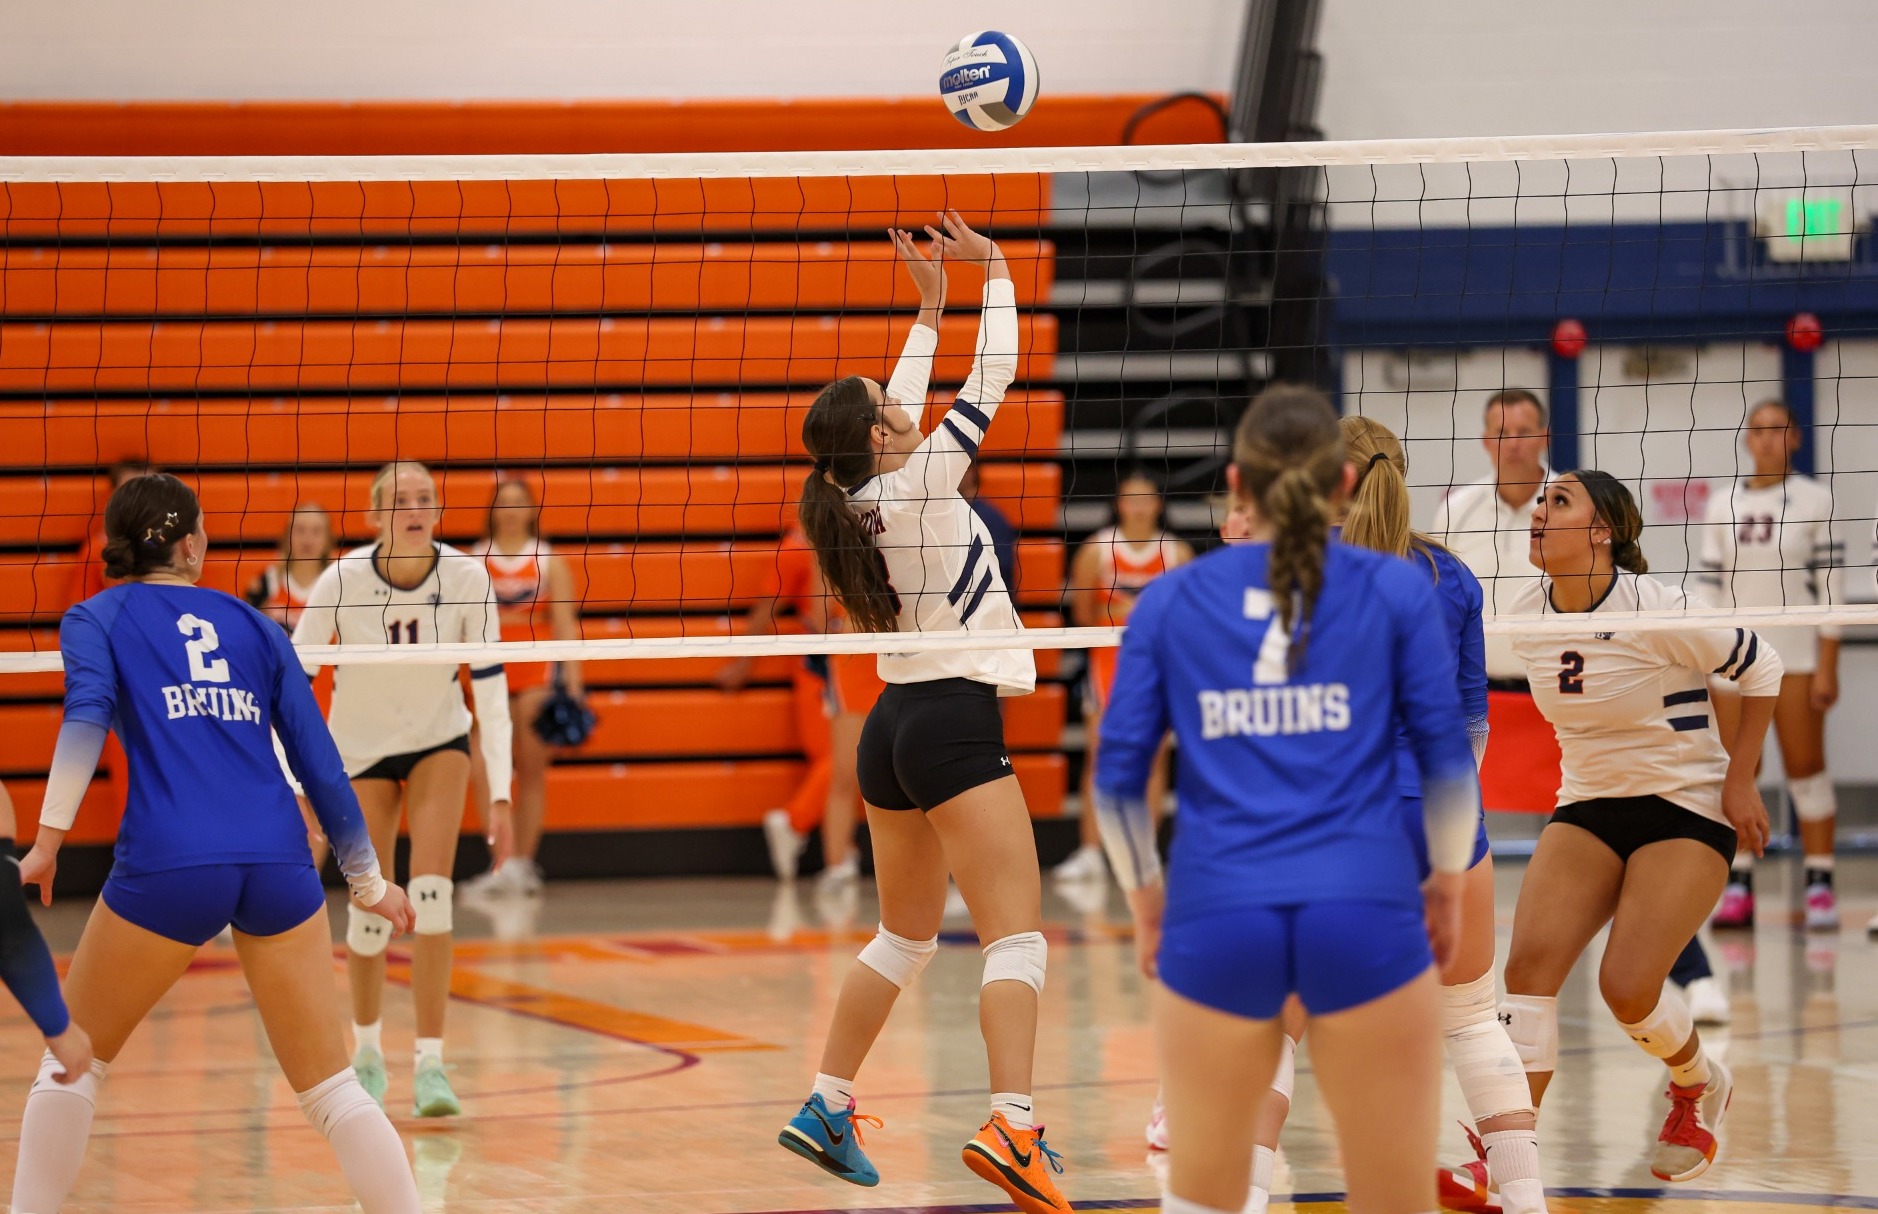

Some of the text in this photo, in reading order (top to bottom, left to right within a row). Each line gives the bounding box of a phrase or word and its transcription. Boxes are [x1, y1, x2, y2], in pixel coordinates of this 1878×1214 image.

[943, 65, 990, 89] molten
[176, 613, 231, 682] 2
[388, 618, 419, 645] 11
[1243, 585, 1301, 685] 7
[1557, 650, 1585, 694] 2
[161, 683, 261, 725] BRUINS
[1198, 682, 1351, 740] BRUINS
